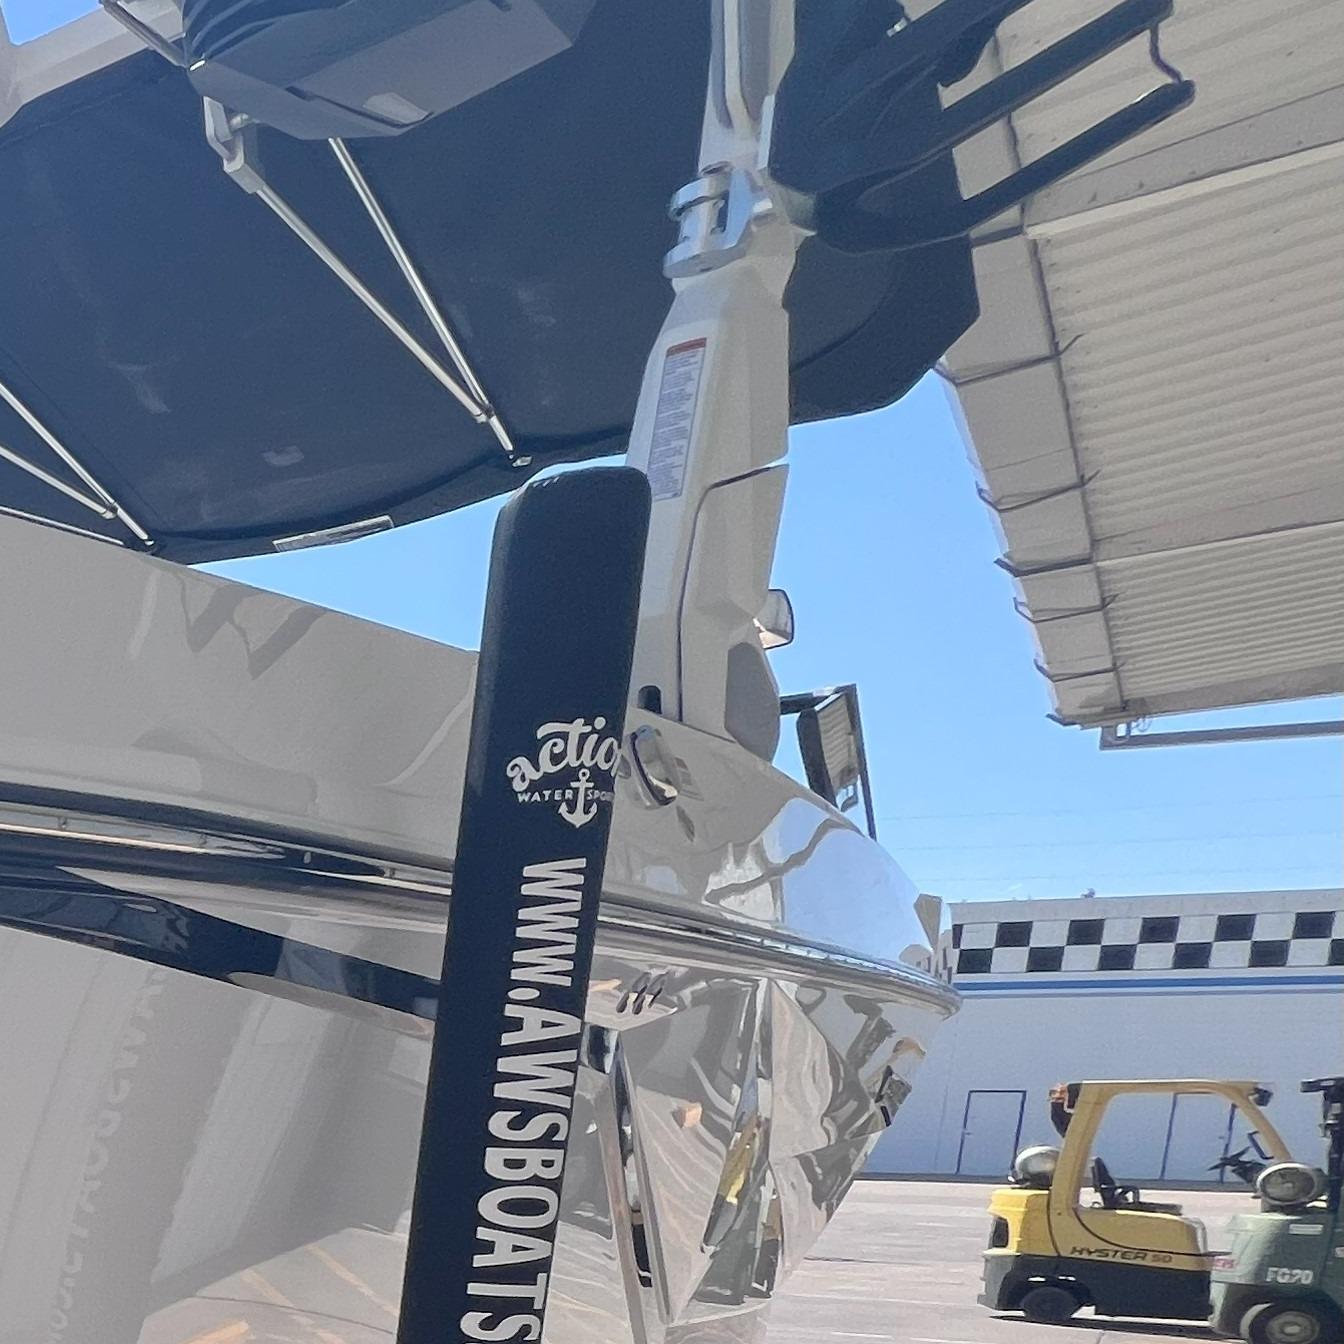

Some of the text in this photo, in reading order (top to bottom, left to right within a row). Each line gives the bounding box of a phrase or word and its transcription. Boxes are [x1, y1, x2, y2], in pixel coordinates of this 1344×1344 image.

[518, 789, 574, 803] WATER
[1069, 1246, 1147, 1262] HYSTER
[1264, 1267, 1314, 1285] FG20
